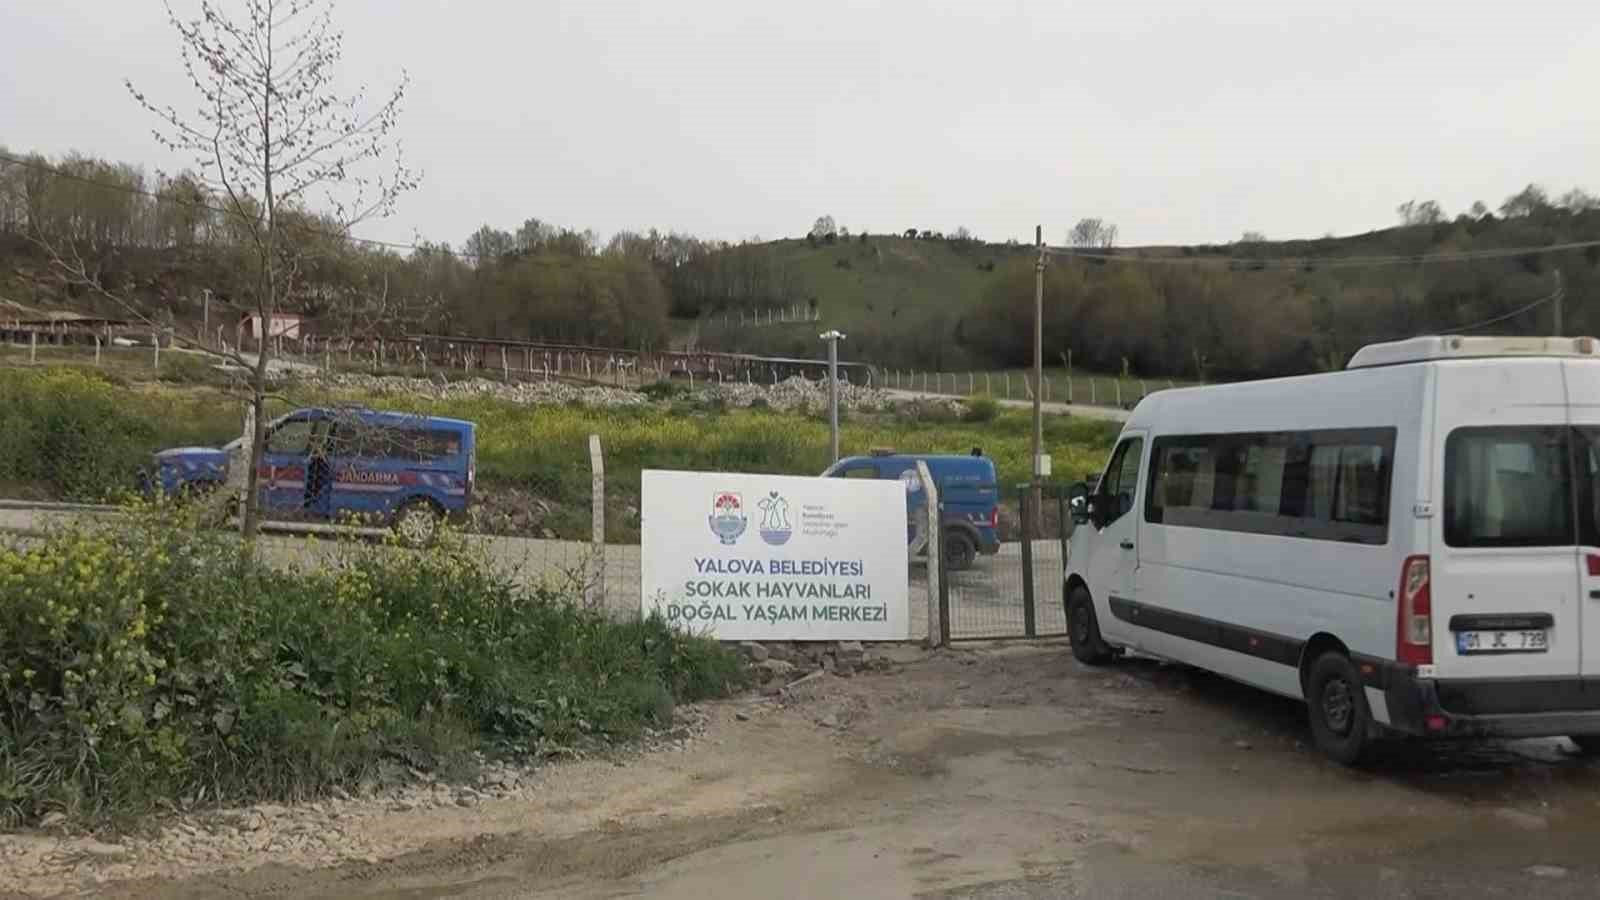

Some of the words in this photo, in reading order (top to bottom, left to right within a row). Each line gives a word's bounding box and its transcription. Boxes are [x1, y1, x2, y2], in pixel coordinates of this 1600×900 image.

[340, 472, 399, 484] JANDARMA
[694, 557, 764, 575] YALOVA
[769, 556, 864, 576] BELEDİYESİ
[685, 581, 751, 598] SOKAK
[756, 582, 871, 599] HAYVANLARI
[667, 601, 737, 622] DOĞAL
[743, 604, 808, 625] YAŞAM
[812, 602, 888, 622] MERKEZİ
